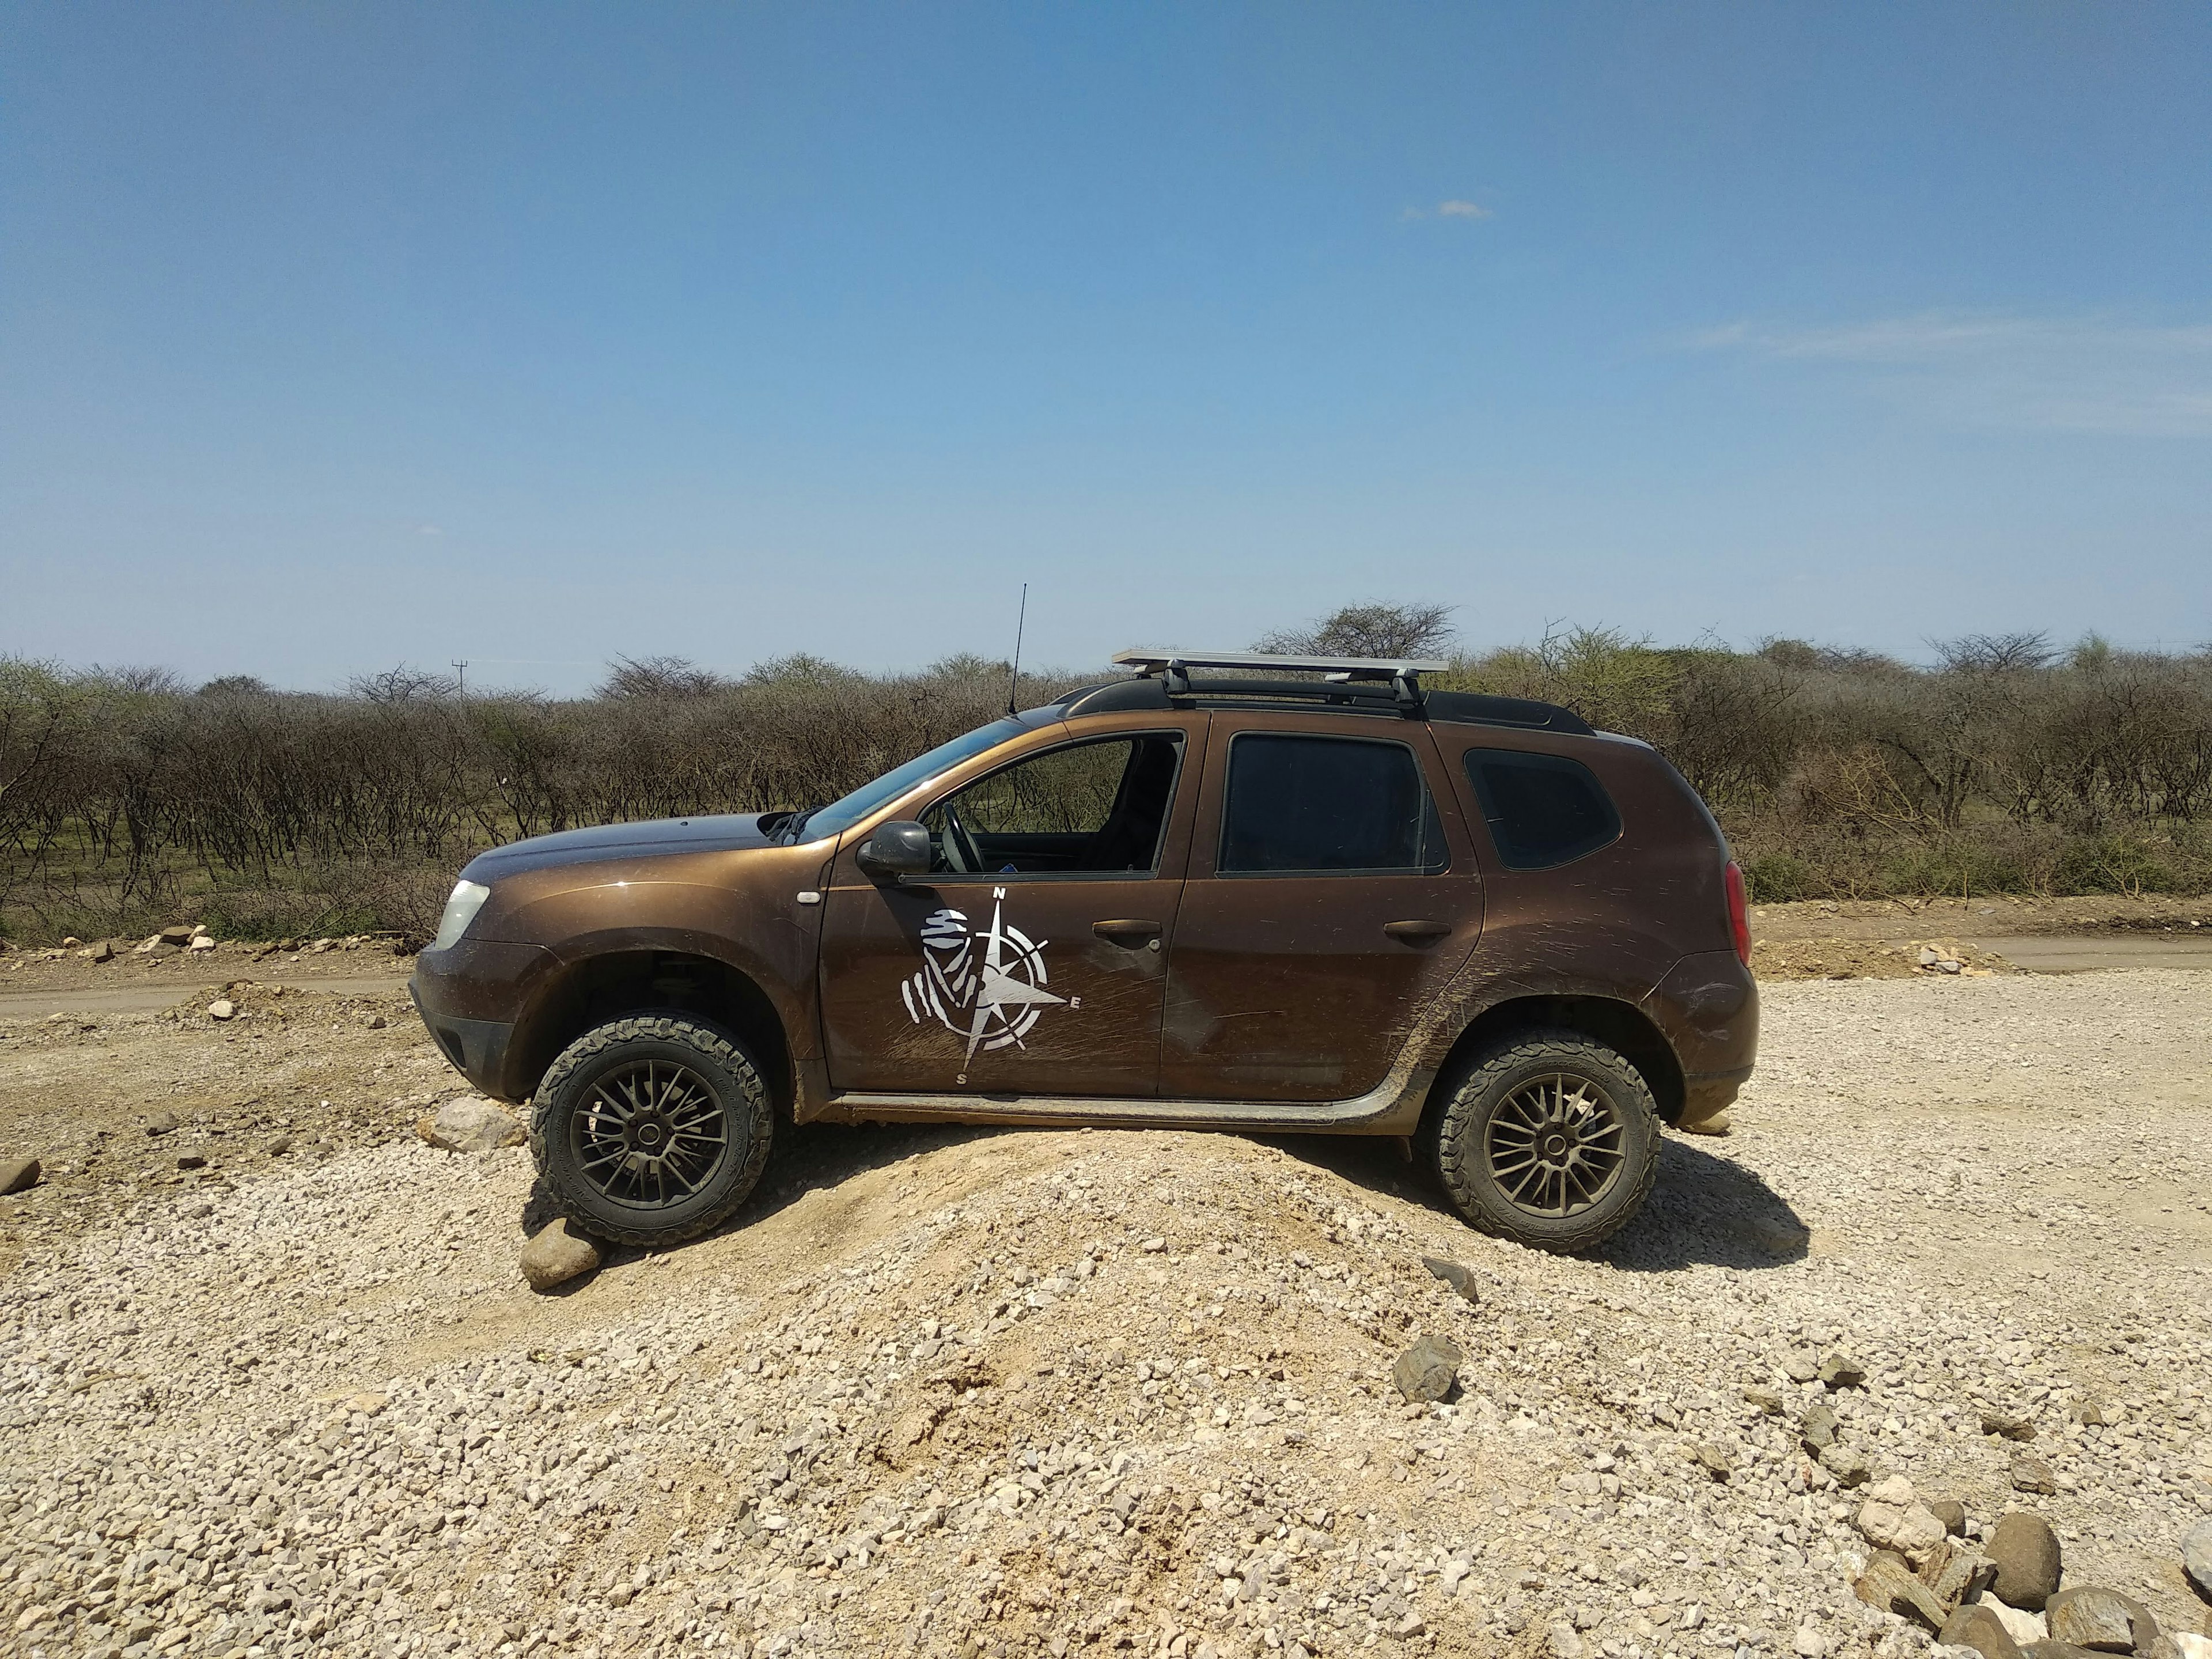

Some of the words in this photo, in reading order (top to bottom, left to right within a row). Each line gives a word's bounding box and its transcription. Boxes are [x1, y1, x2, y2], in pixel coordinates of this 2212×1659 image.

[993, 887, 1006, 900] N
[1069, 996, 1081, 1009] E
[956, 1073, 967, 1085] S
